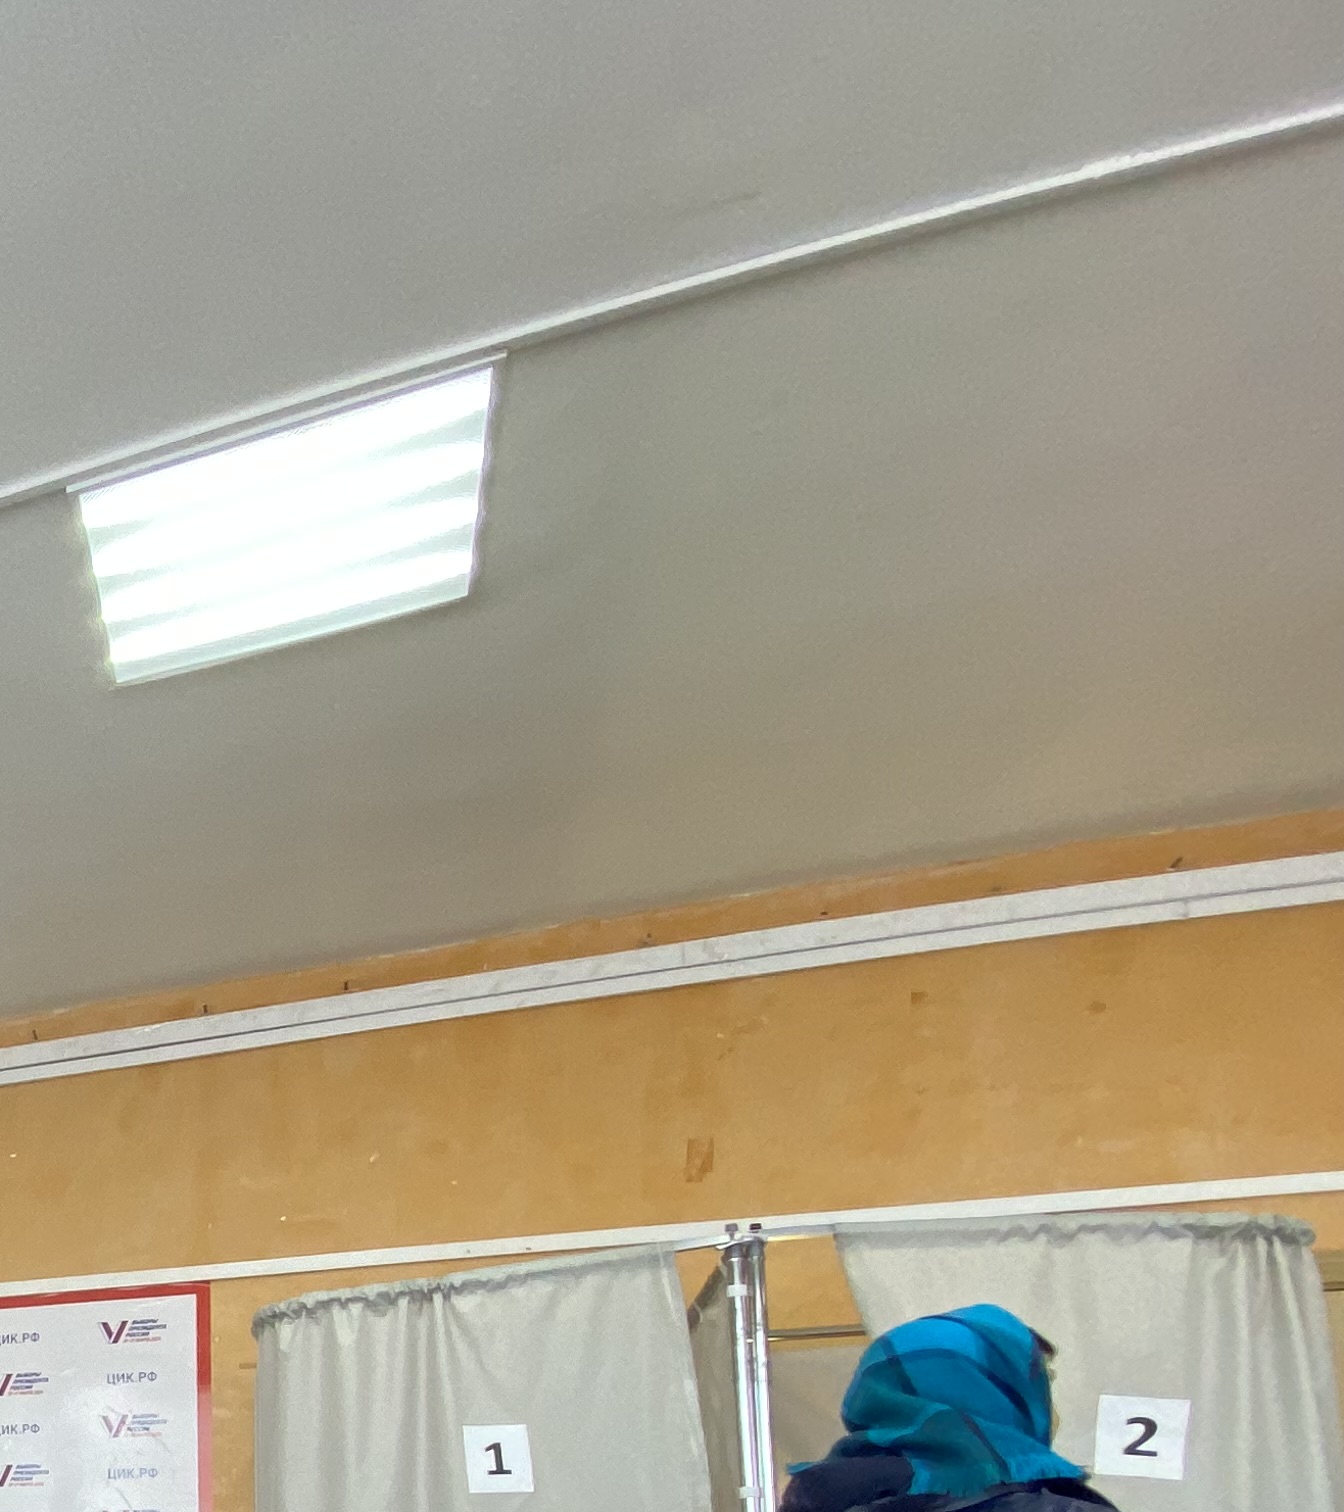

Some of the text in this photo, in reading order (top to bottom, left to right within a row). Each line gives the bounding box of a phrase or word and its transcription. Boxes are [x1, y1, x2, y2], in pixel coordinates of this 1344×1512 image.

[106, 1371, 157, 1385] ЦИК.РФ
[1123, 1416, 1158, 1457] 2
[484, 1442, 512, 1475] 1
[107, 1467, 159, 1480] ЦИК.РФ
